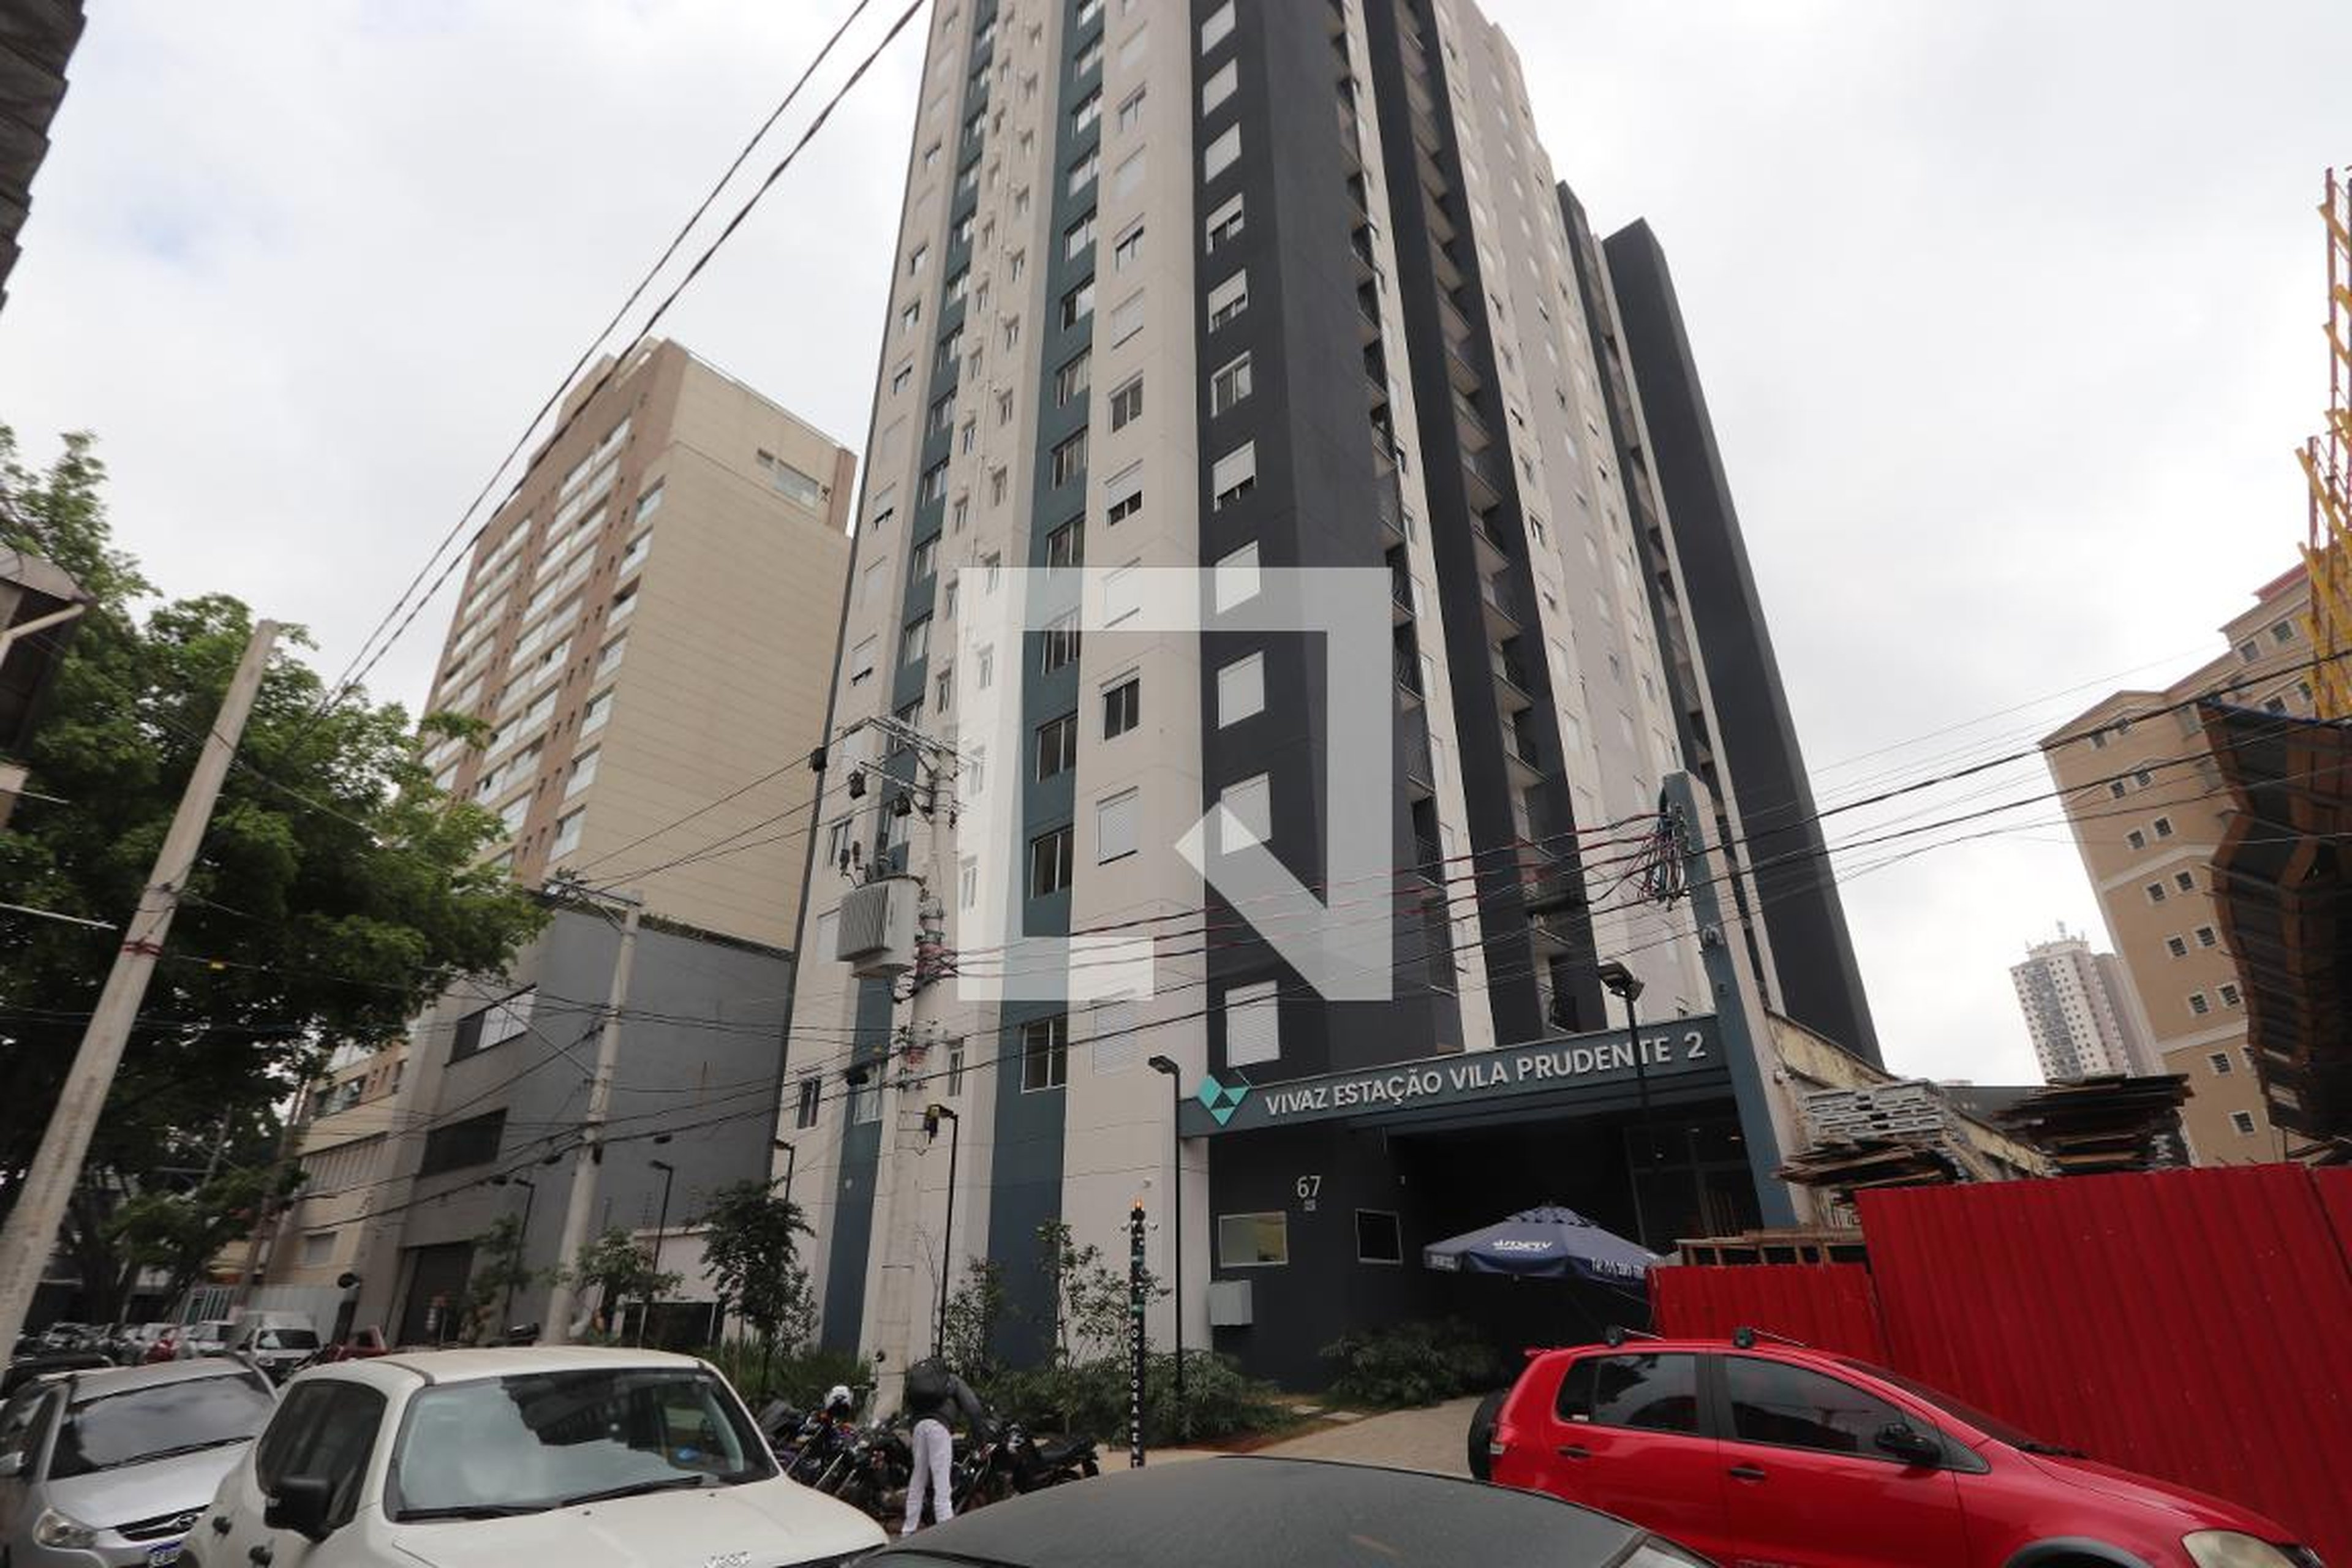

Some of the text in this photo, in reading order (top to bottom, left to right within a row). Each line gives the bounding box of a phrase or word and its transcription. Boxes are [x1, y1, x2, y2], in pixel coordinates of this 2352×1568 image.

[1265, 1031, 1706, 1115] VIVAZ ESTAÇÃO VILA PRUDENTE 2
[1297, 1175, 1321, 1198] 67
